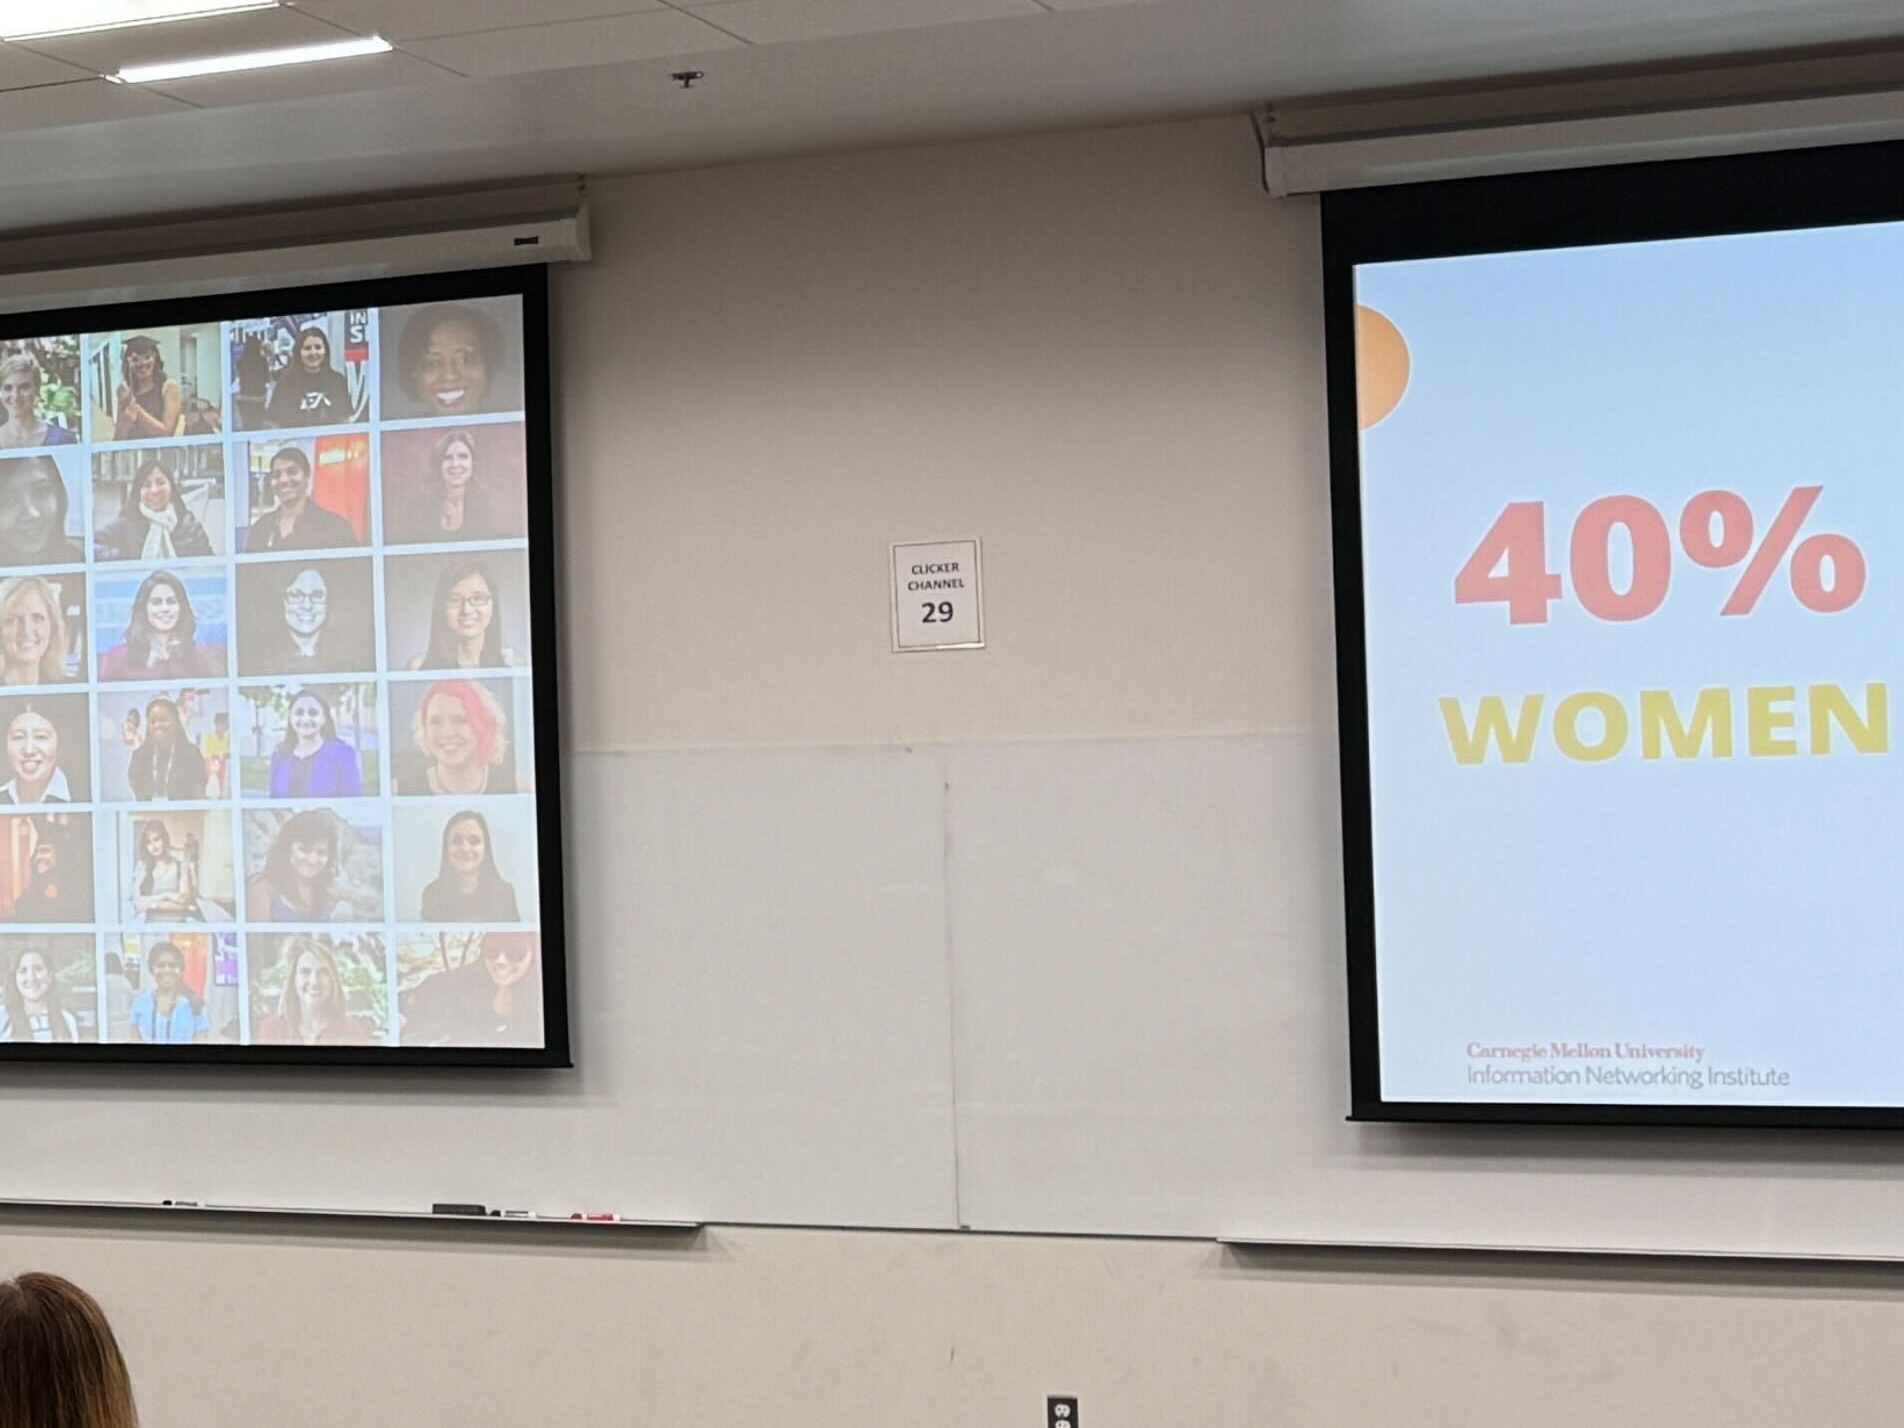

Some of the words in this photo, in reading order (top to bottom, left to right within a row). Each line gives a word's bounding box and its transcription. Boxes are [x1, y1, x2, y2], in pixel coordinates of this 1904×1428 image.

[1453, 485, 1868, 626] 40%
[911, 562, 960, 575] CLICKER
[907, 578, 965, 592] CHANNEL
[921, 601, 954, 624] 29
[1437, 681, 1890, 766] WOMEN
[1466, 1041, 1548, 1063] Carnegie
[1550, 1042, 1612, 1059] Mellon
[1614, 1042, 1705, 1062] University
[1467, 1065, 1582, 1086] Information
[1585, 1066, 1704, 1089] Networking
[1708, 1067, 1791, 1087] Institute
